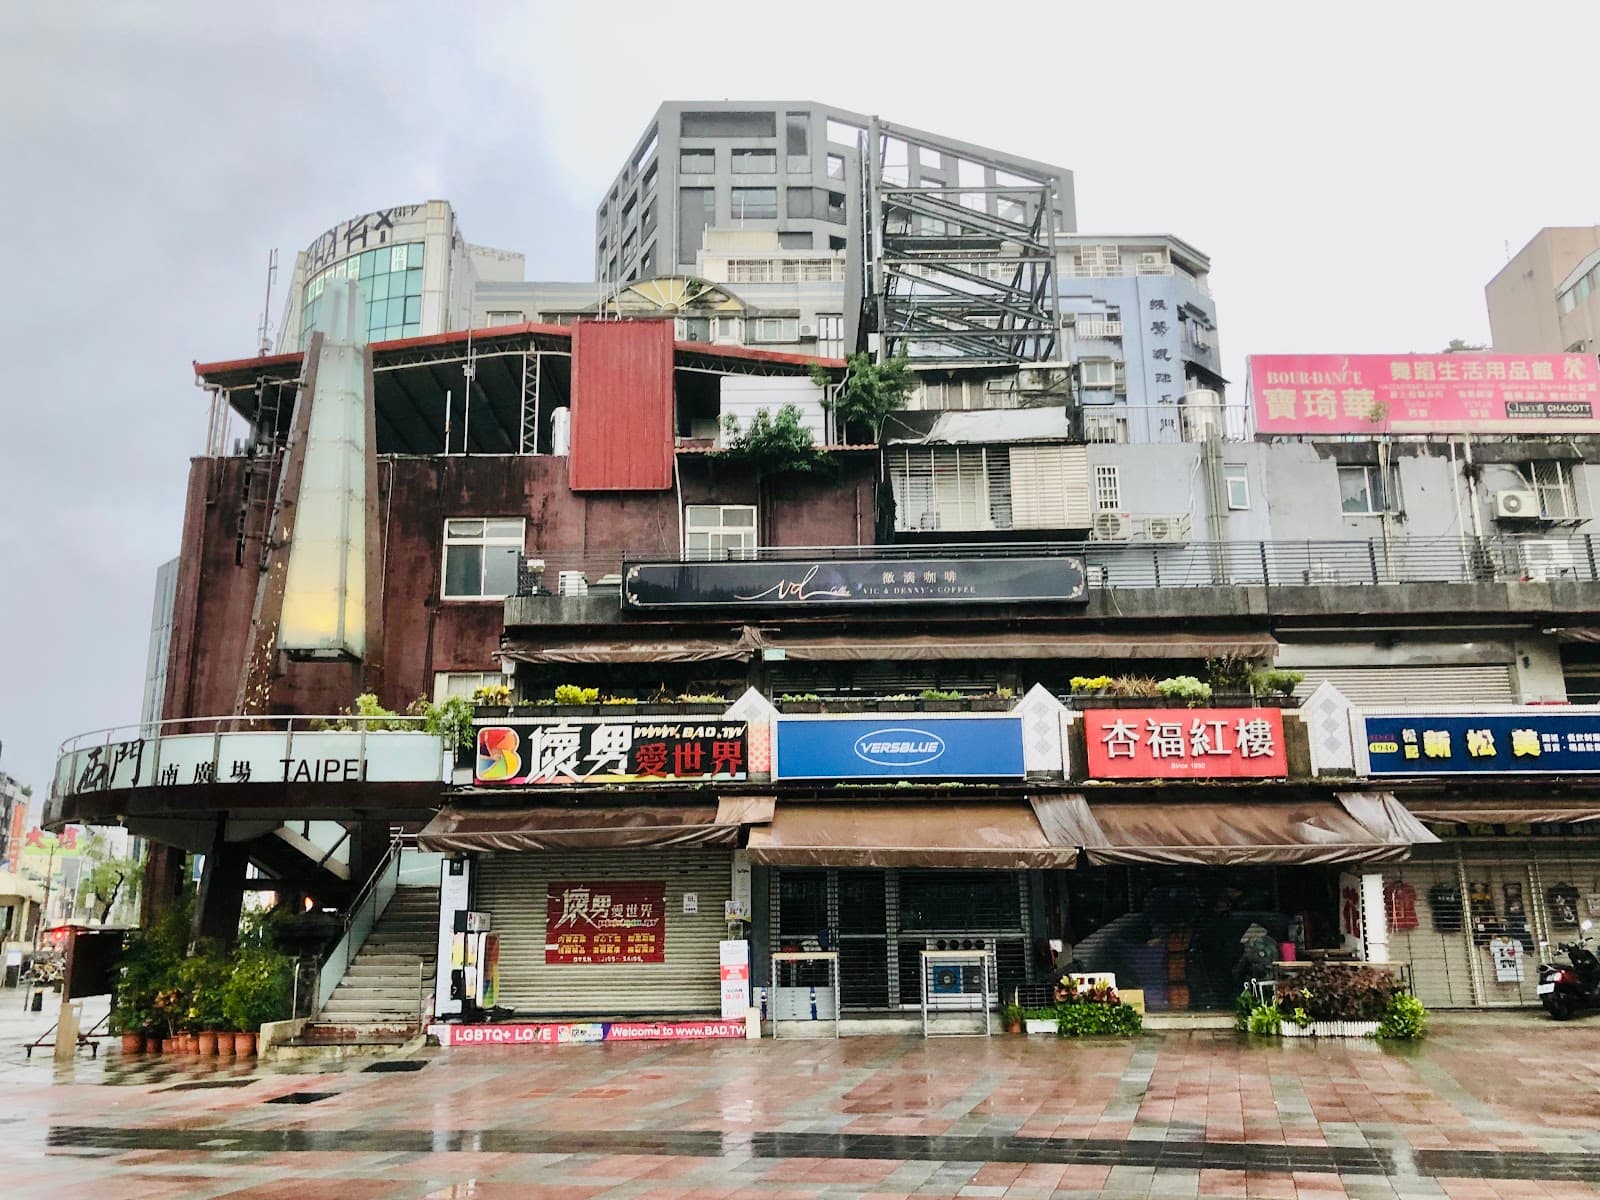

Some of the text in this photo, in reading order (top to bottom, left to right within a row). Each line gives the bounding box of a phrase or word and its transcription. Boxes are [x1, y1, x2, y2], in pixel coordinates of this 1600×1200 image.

[860, 741, 940, 754] VERSBLUE
[1102, 718, 1275, 759] 杏福紅樓
[76, 739, 253, 794] 西門 南廣場
[279, 759, 368, 784] TAIPEI
[634, 741, 743, 778] 愛世界
[455, 1028, 511, 1041] LGBTQ+
[611, 1026, 660, 1037] Welcome
[663, 1026, 674, 1036] to
